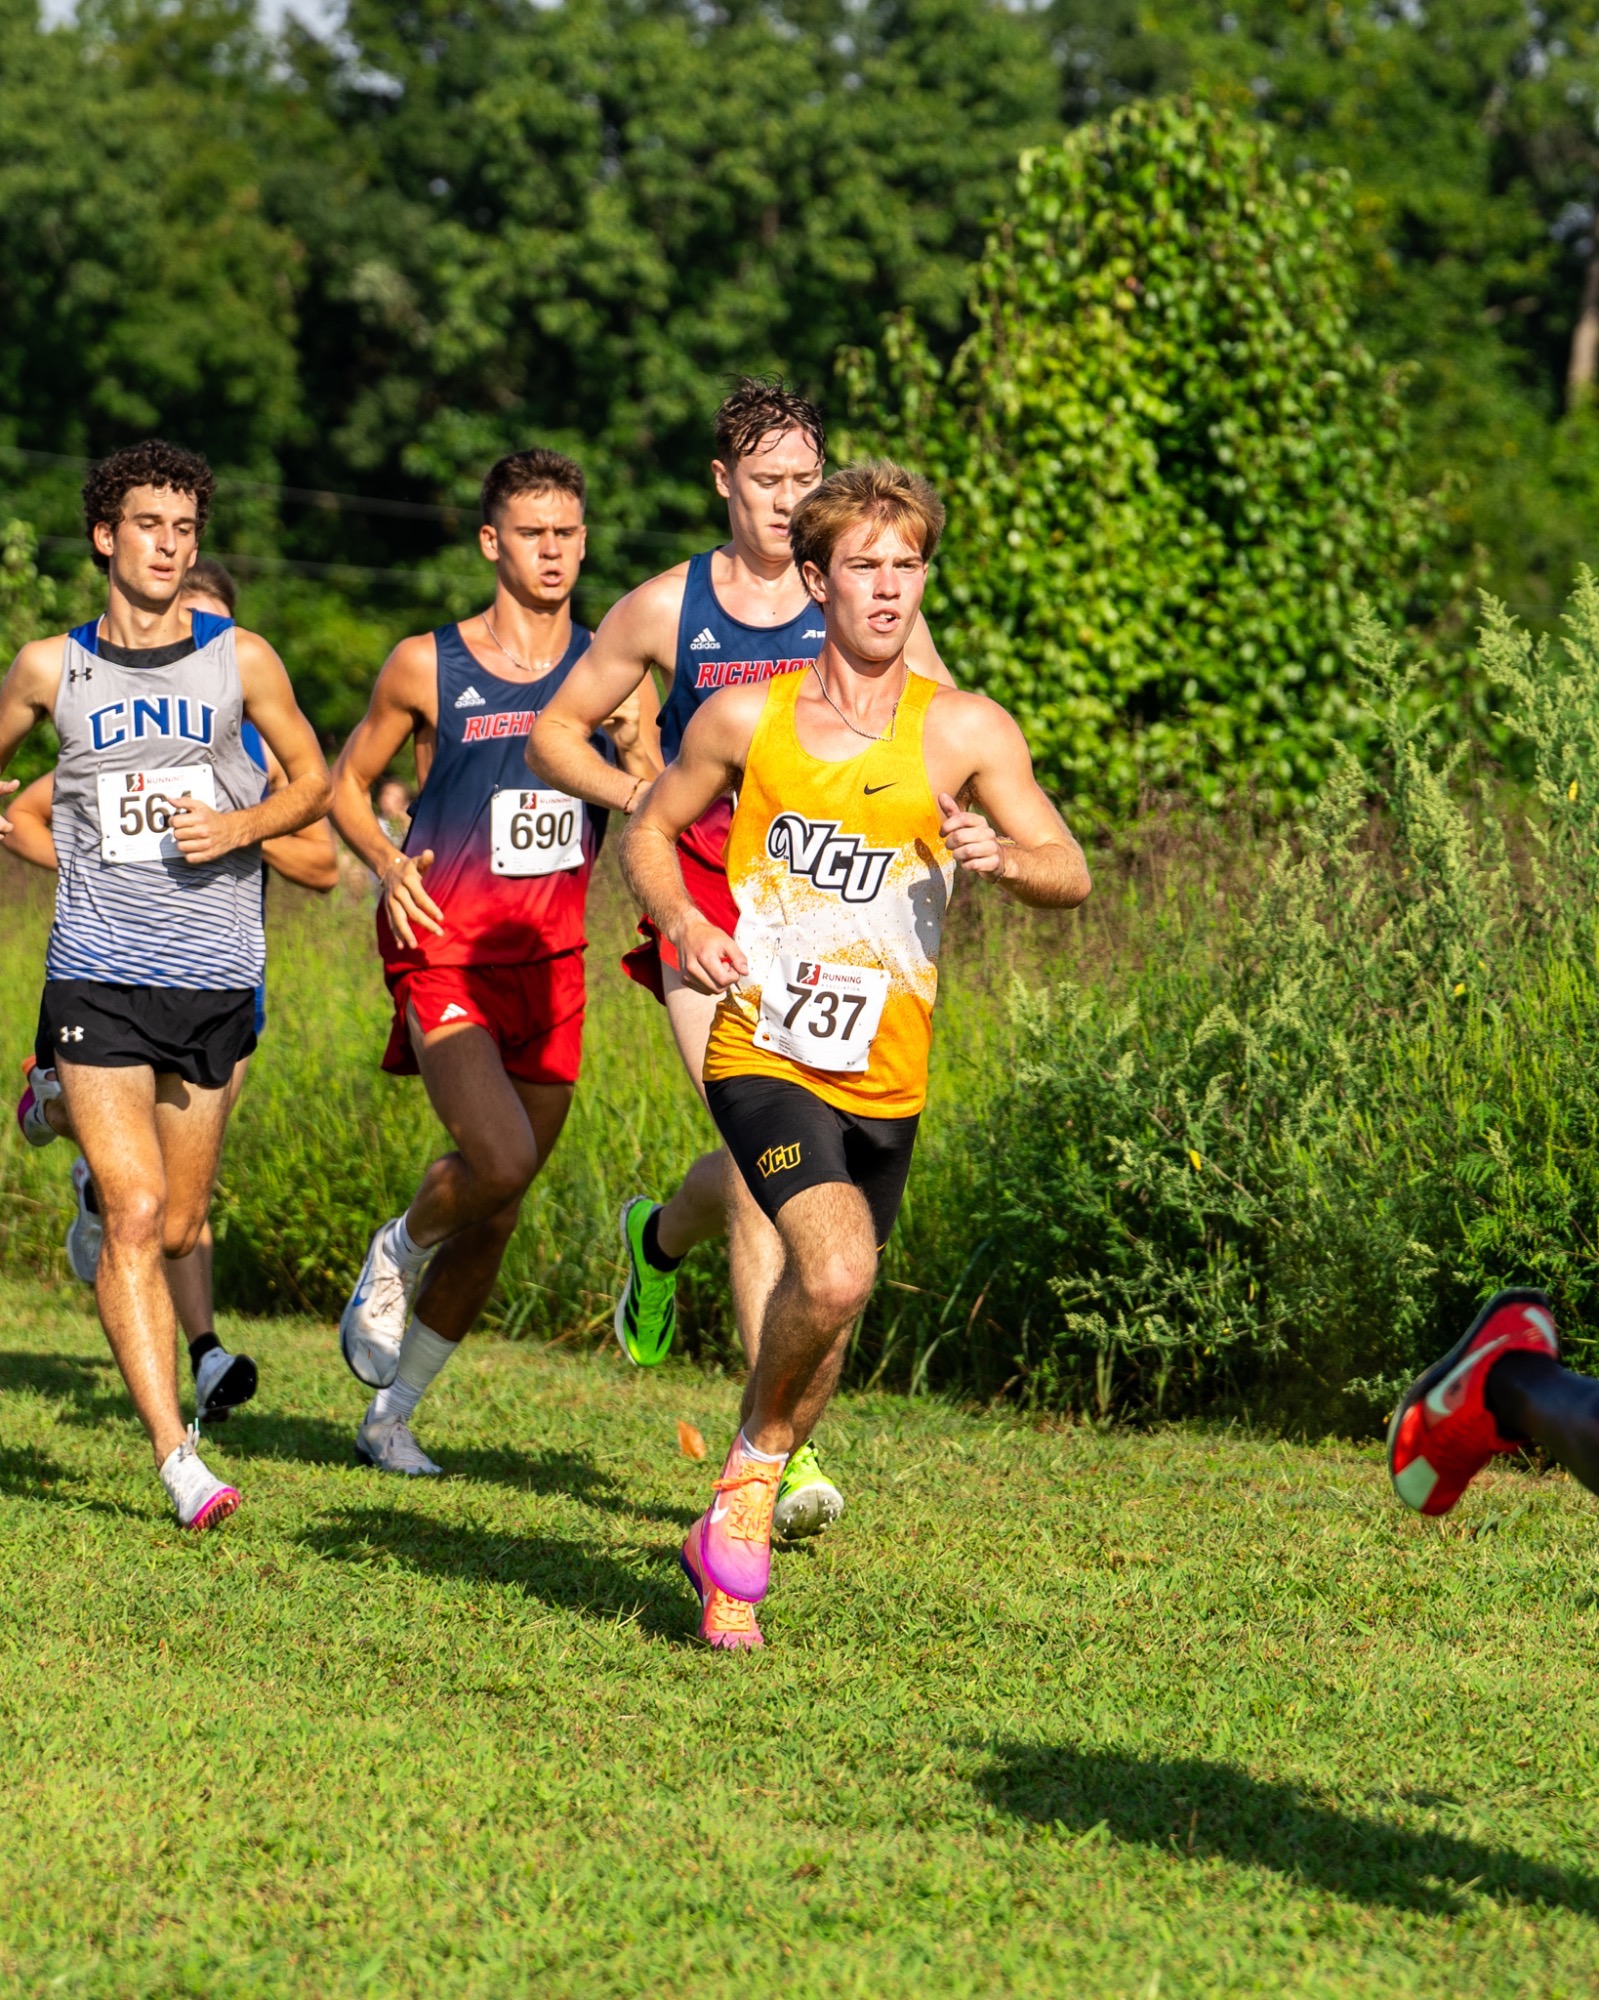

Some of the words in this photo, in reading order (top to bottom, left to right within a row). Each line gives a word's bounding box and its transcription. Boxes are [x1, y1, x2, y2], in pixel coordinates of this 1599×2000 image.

[690, 641, 721, 650] adidas
[695, 658, 816, 688] RICHMO
[85, 694, 218, 753] CNU
[119, 790, 192, 836] 56
[510, 810, 574, 850] 690
[766, 811, 898, 903] VCU
[822, 972, 862, 984] RUNNING
[782, 983, 867, 1041] 737
[756, 1142, 801, 1178] VCU
